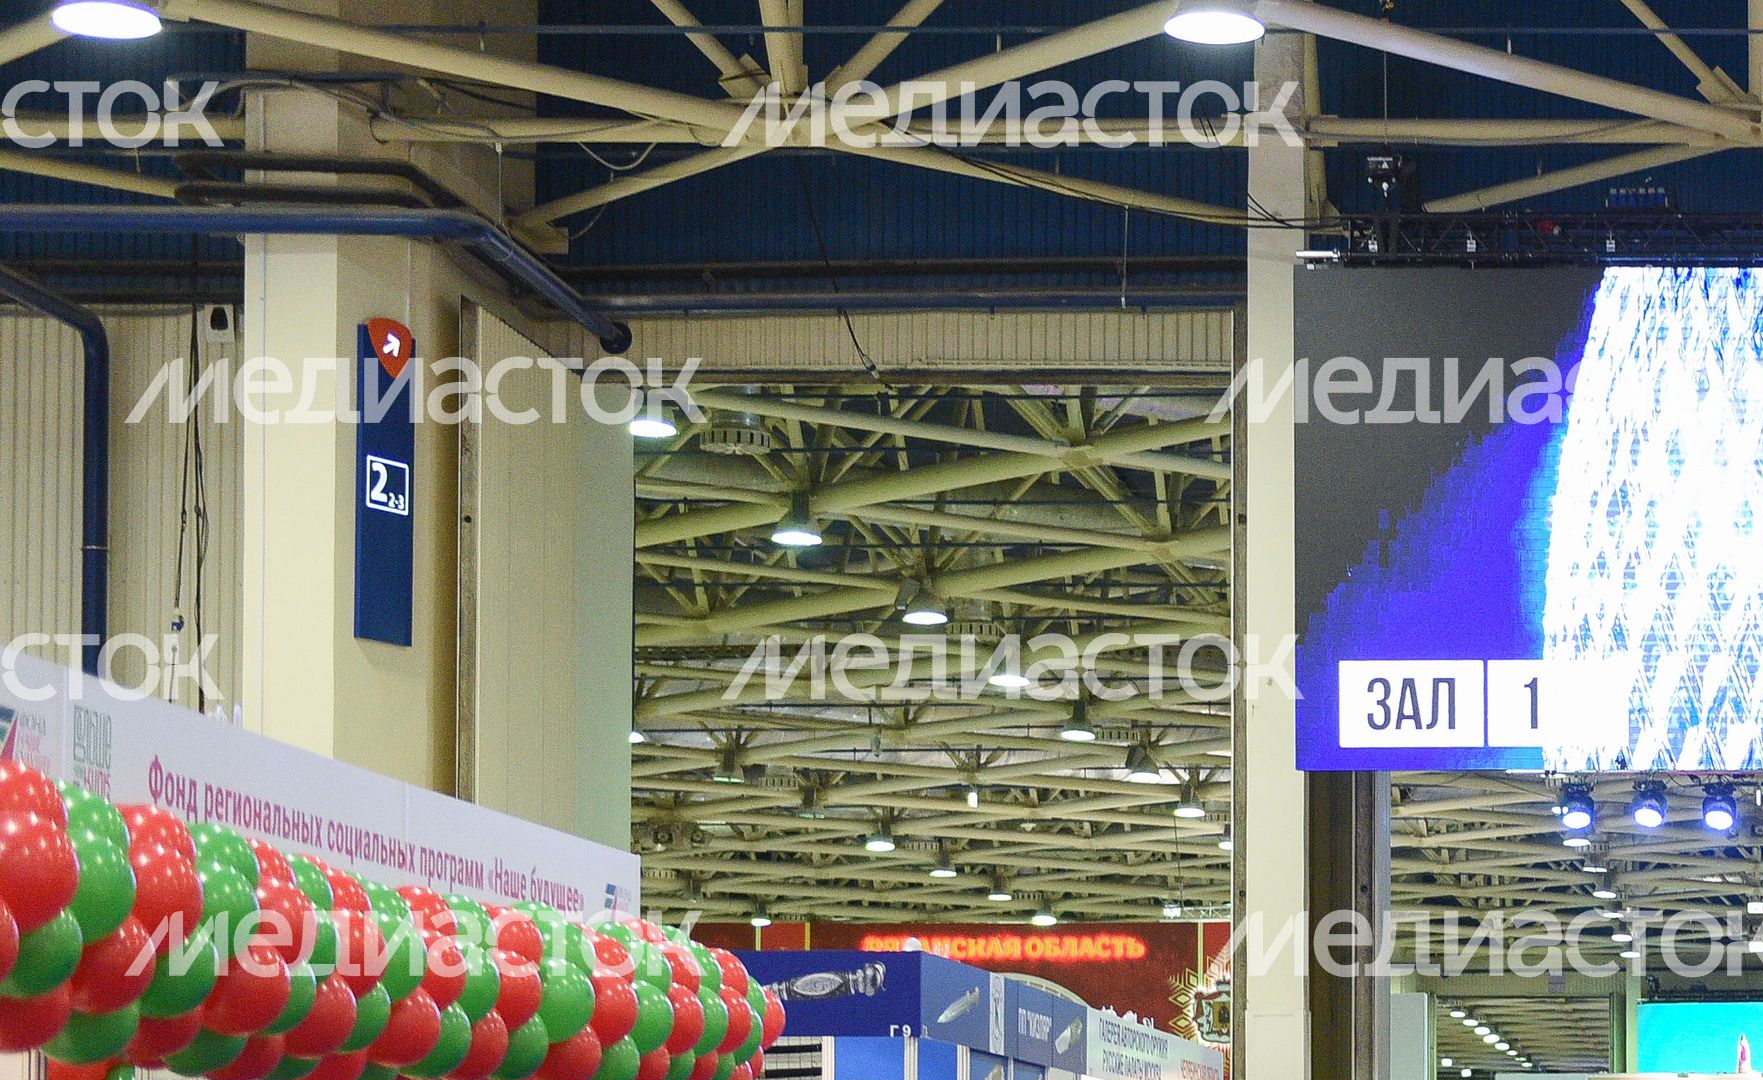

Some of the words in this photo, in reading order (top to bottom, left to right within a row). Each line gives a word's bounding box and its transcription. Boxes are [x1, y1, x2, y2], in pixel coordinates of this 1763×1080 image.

[371, 462, 388, 503] 2
[1366, 677, 1457, 730] ЗАЛ
[1523, 677, 1540, 728] 1
[149, 754, 199, 824] Фонд
[204, 782, 323, 848] региональных
[326, 819, 416, 875] социальных
[420, 846, 484, 893] программ
[1025, 935, 1145, 959] ОБЛАСТЬ
